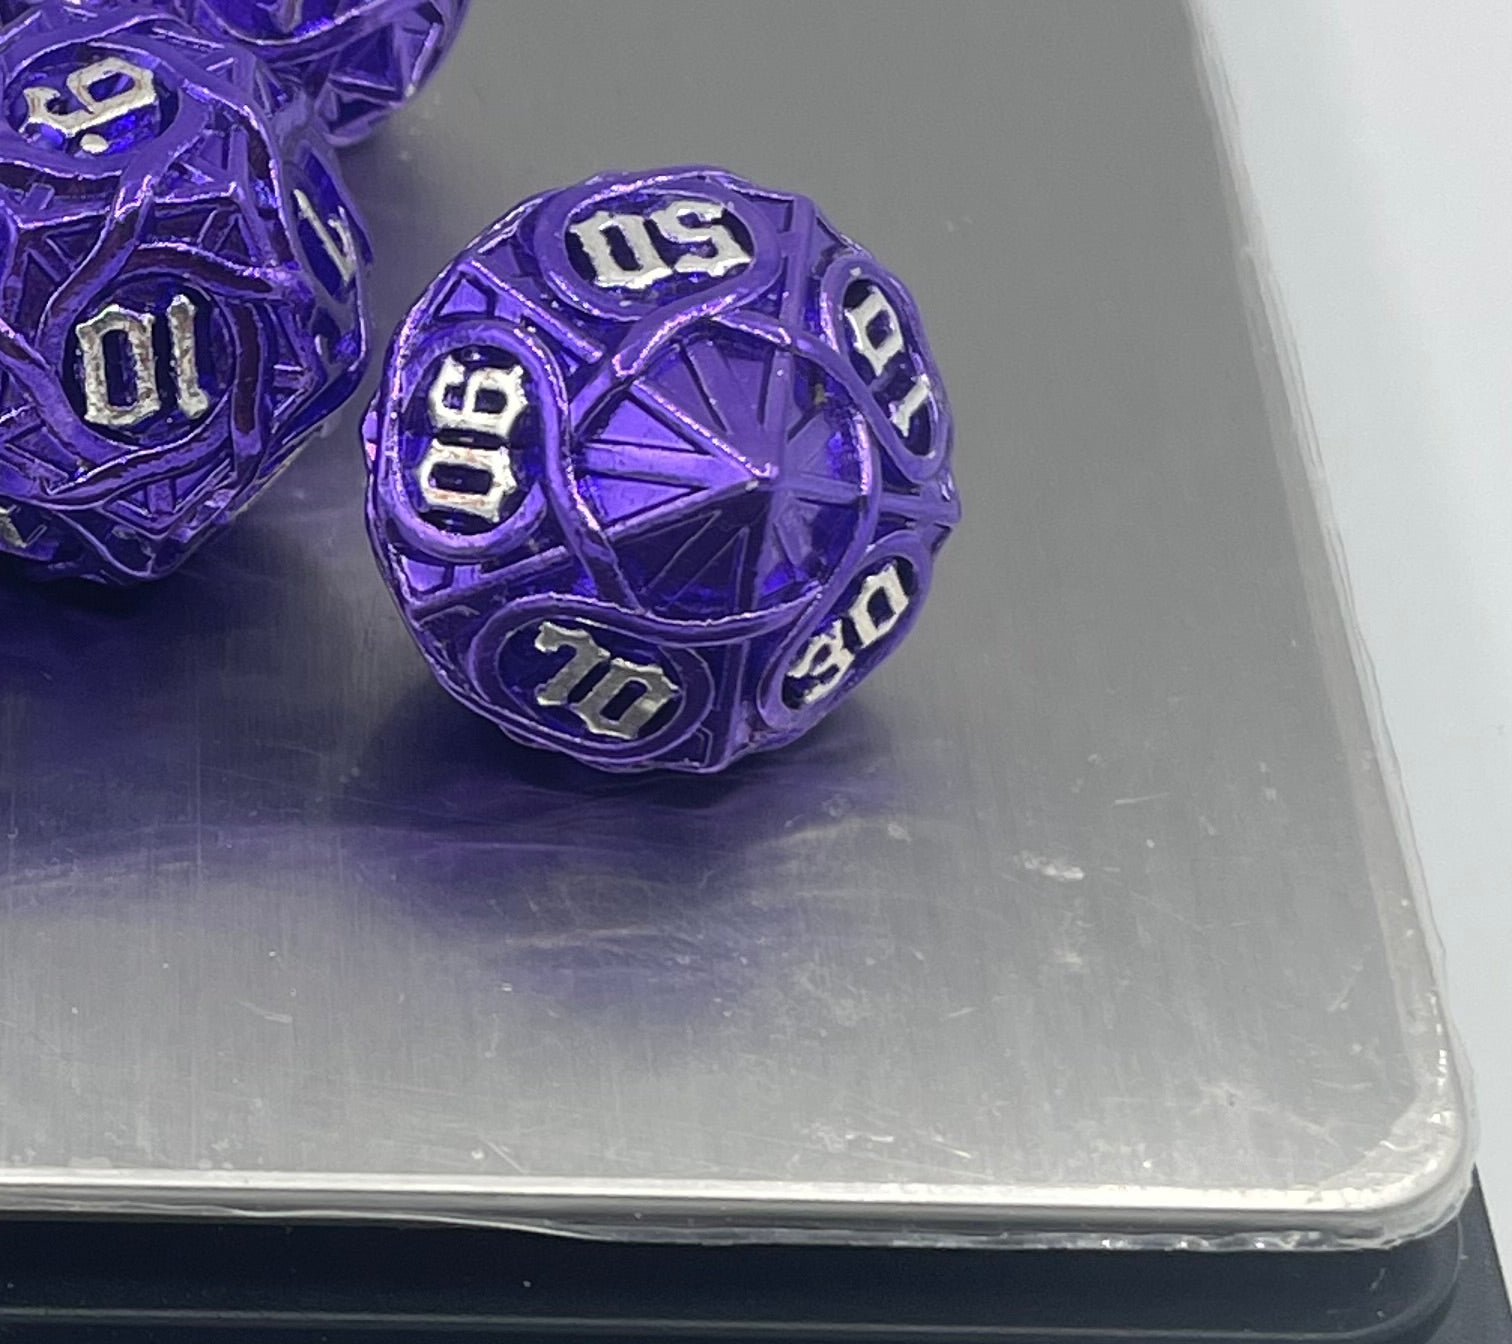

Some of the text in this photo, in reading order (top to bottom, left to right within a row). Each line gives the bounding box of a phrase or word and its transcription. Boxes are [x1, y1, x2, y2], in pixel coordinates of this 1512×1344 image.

[419, 354, 530, 522] 90
[533, 620, 681, 740] 70
[787, 560, 911, 705] 30
